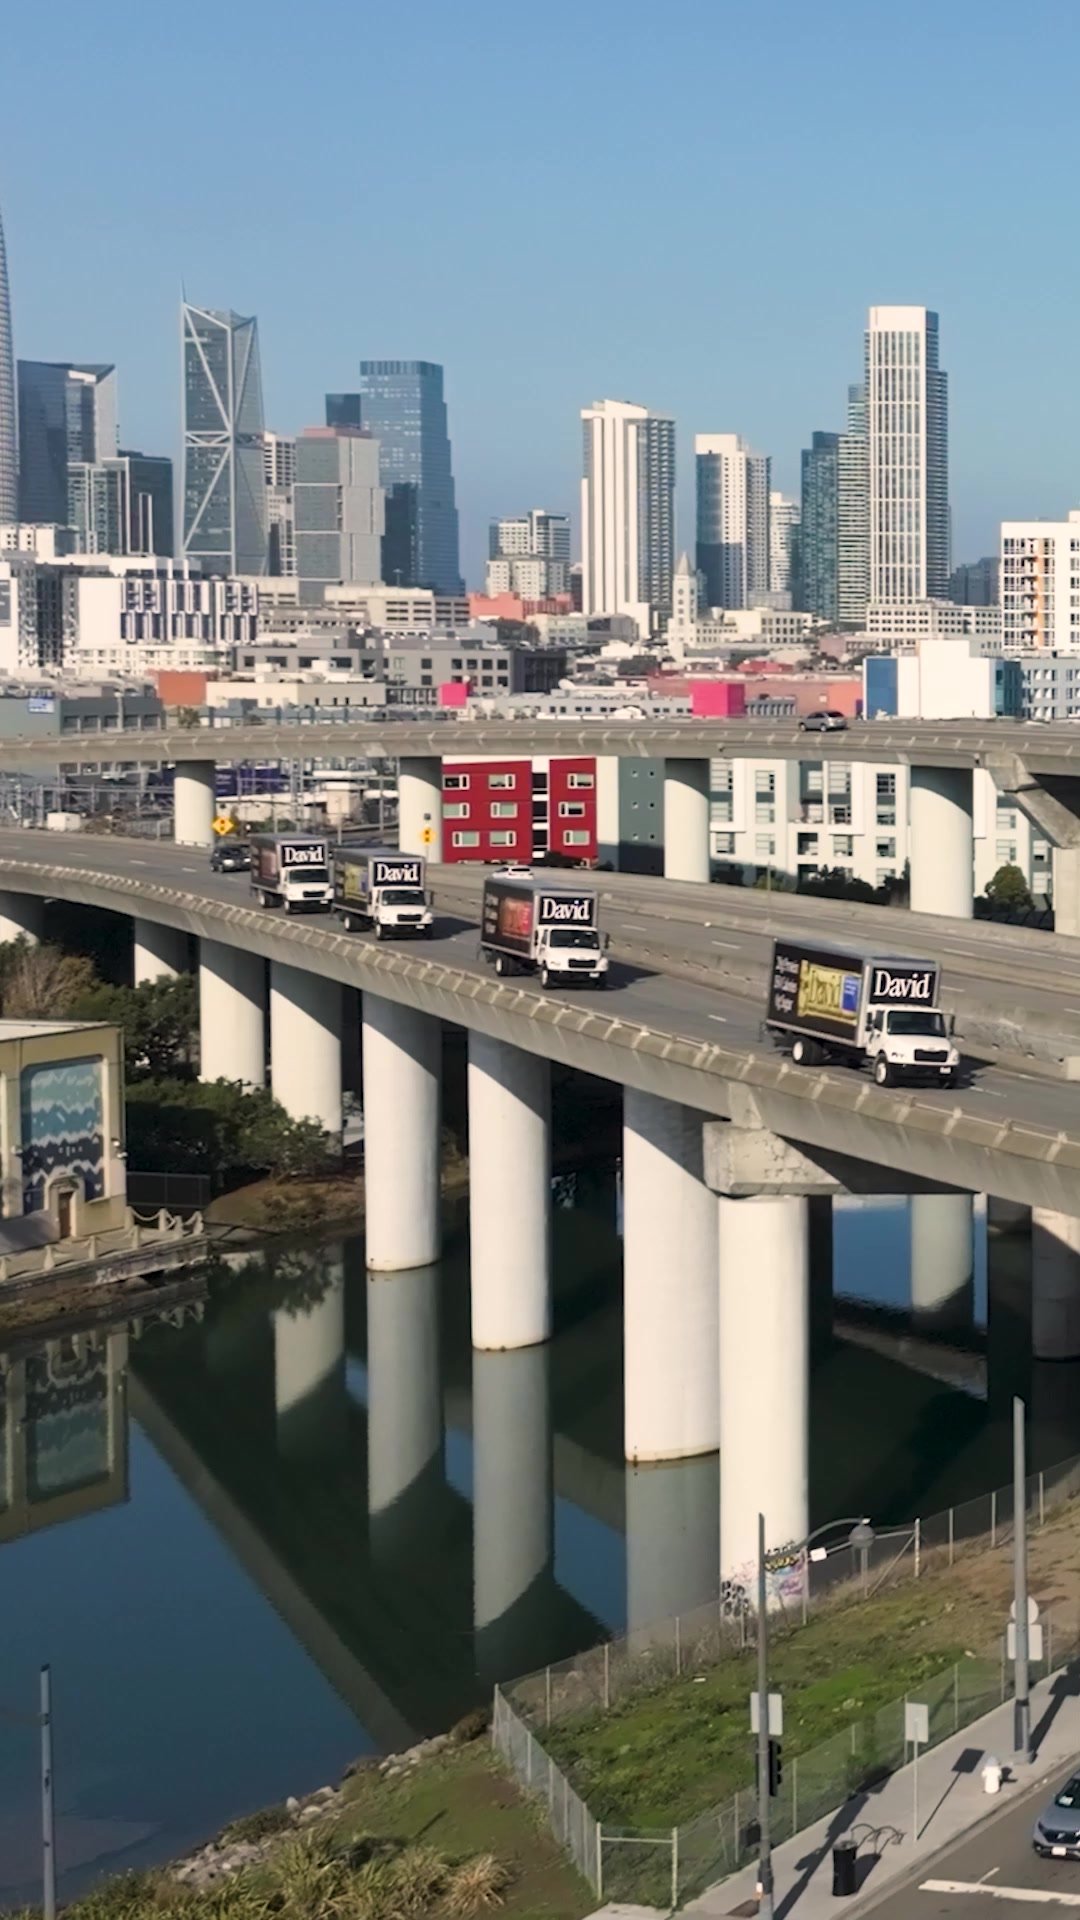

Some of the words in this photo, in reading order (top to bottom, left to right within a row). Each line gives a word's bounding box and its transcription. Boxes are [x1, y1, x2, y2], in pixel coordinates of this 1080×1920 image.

[284, 846, 324, 863] David
[376, 863, 419, 882] David
[541, 898, 590, 920] David
[873, 970, 932, 999] David
